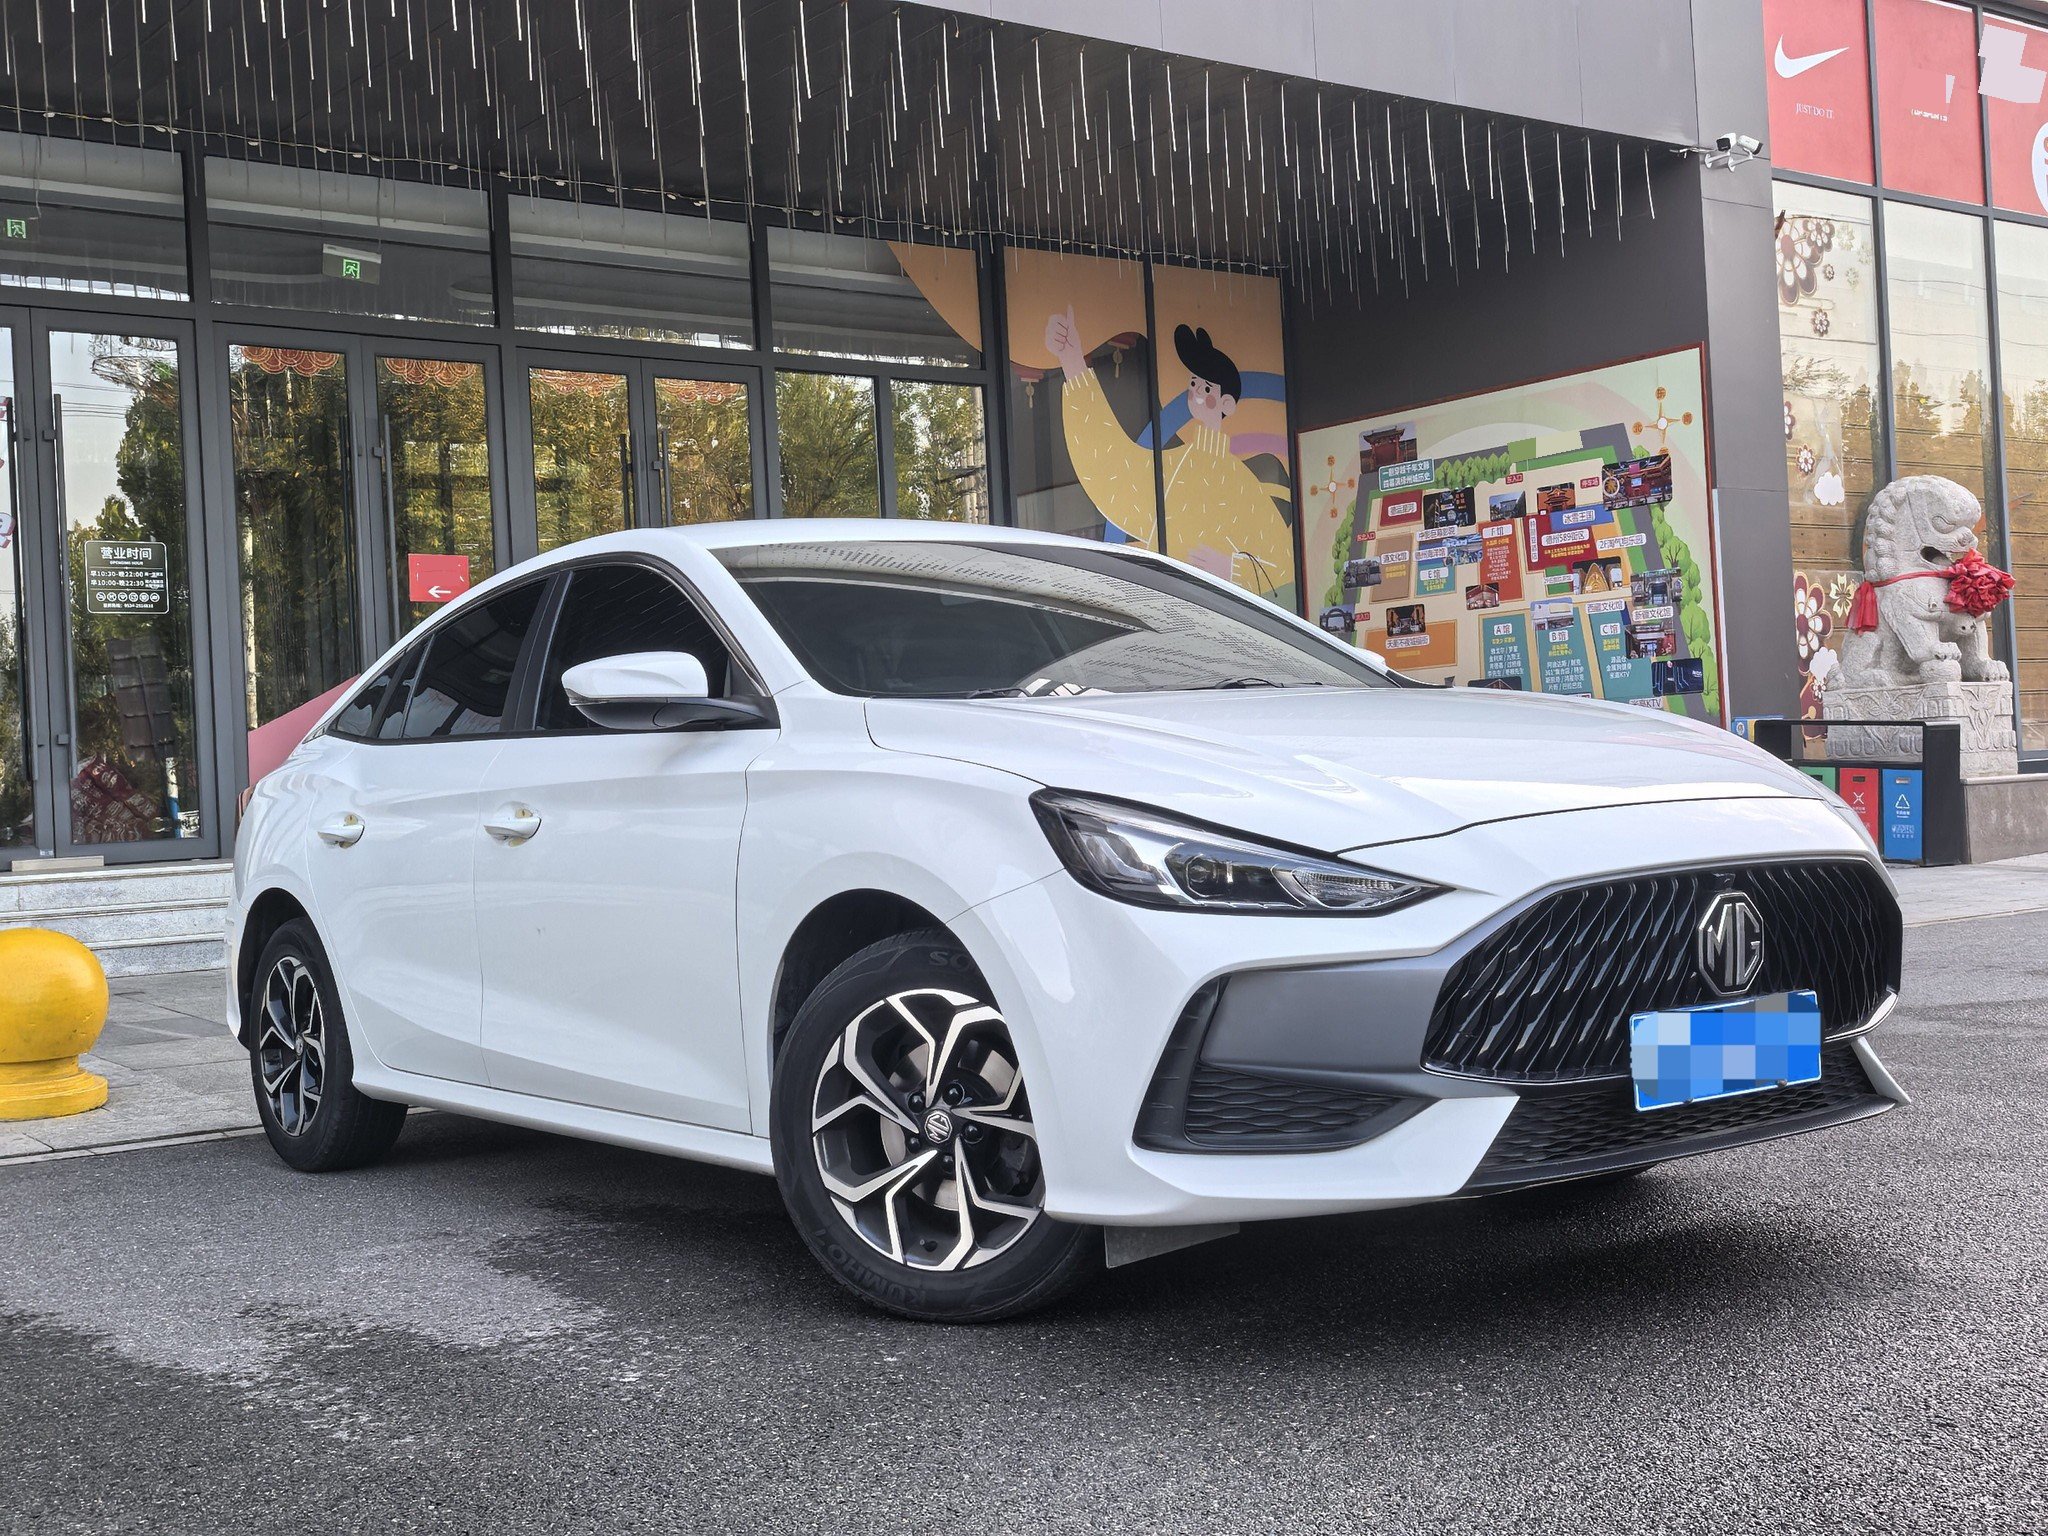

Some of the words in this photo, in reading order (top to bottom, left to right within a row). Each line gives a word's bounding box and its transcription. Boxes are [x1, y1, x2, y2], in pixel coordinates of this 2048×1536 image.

[1796, 103, 1812, 115] JUST
[1813, 106, 1825, 117] DO
[101, 546, 151, 560] 营业时间
[1706, 902, 1761, 987] MG
